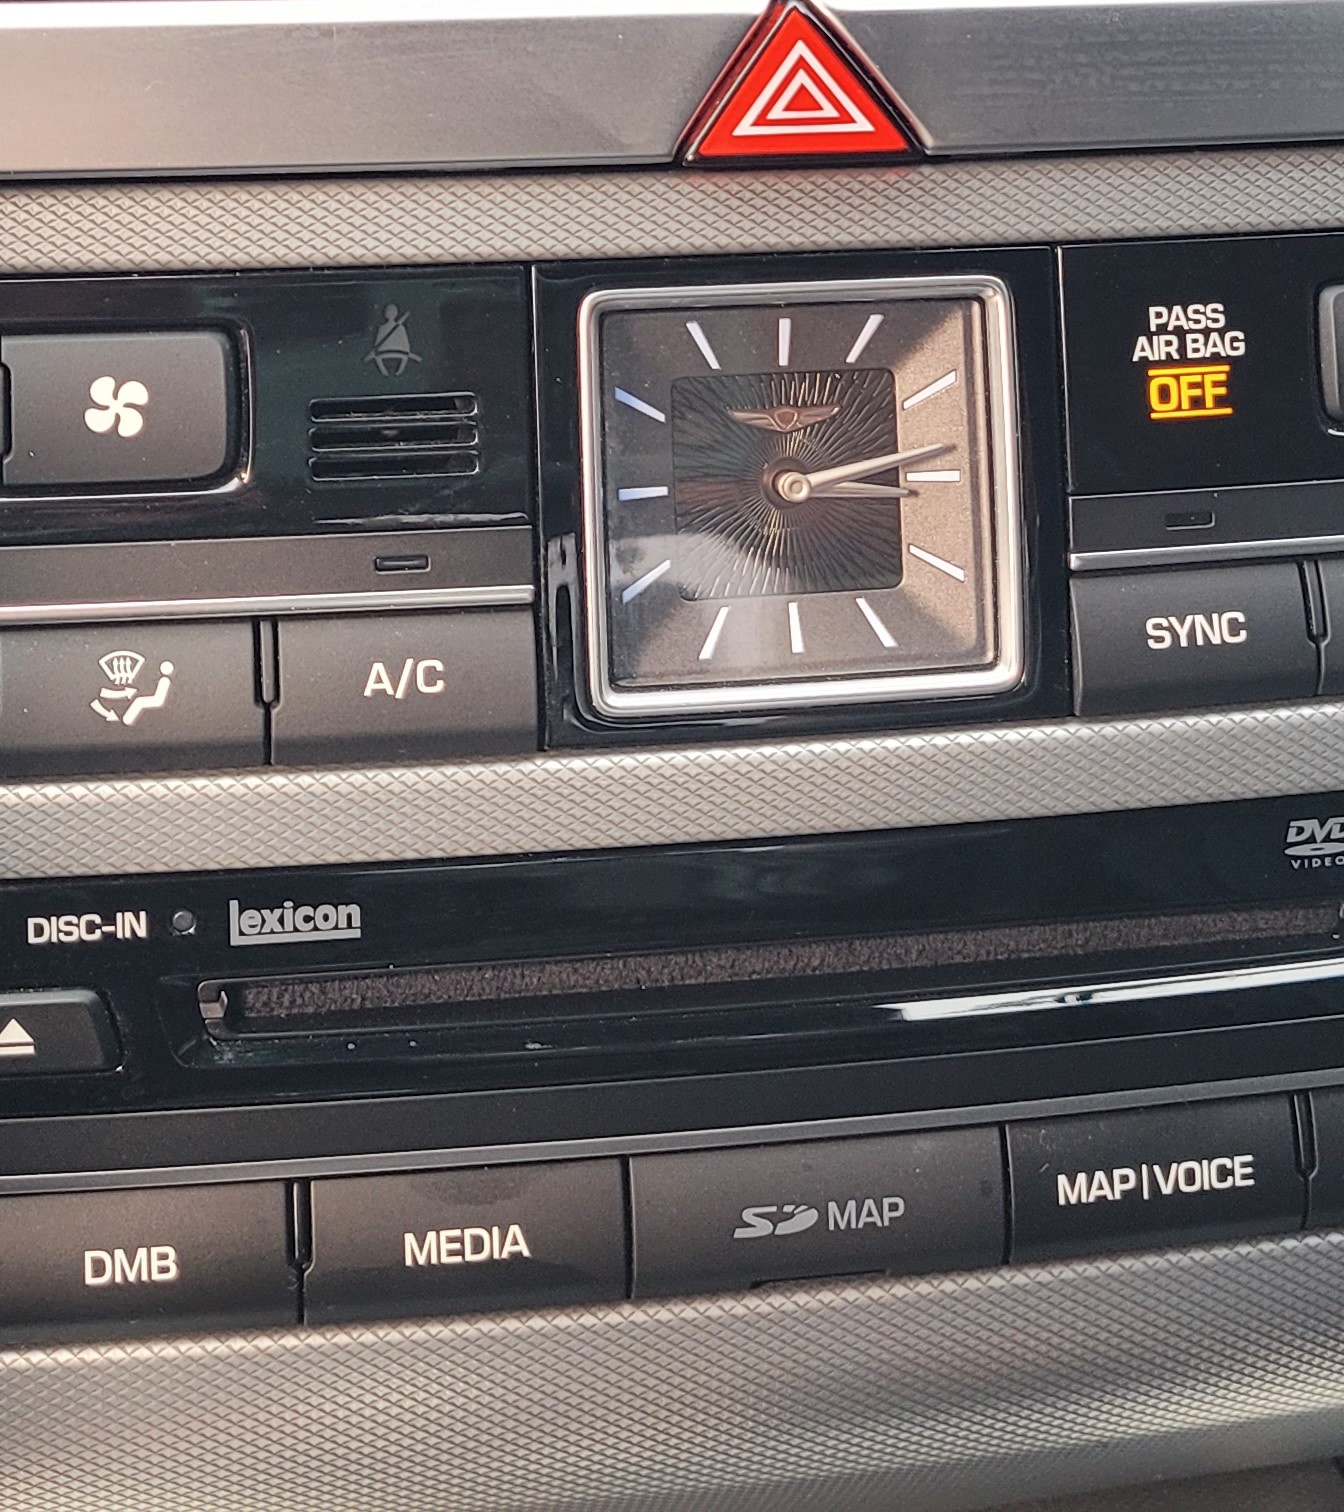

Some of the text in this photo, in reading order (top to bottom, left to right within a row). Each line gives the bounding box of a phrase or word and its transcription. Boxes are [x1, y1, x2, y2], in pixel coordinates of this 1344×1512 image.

[1147, 302, 1226, 332] PASS
[1132, 326, 1246, 362] AIR BAG
[1148, 375, 1230, 410] OFF
[1145, 611, 1248, 650] SYNC
[363, 658, 445, 699] A/C
[27, 910, 147, 944] DISC-IN
[827, 1196, 905, 1231] MAP
[404, 1224, 531, 1266] MEDIA
[84, 1245, 178, 1286] DMB
